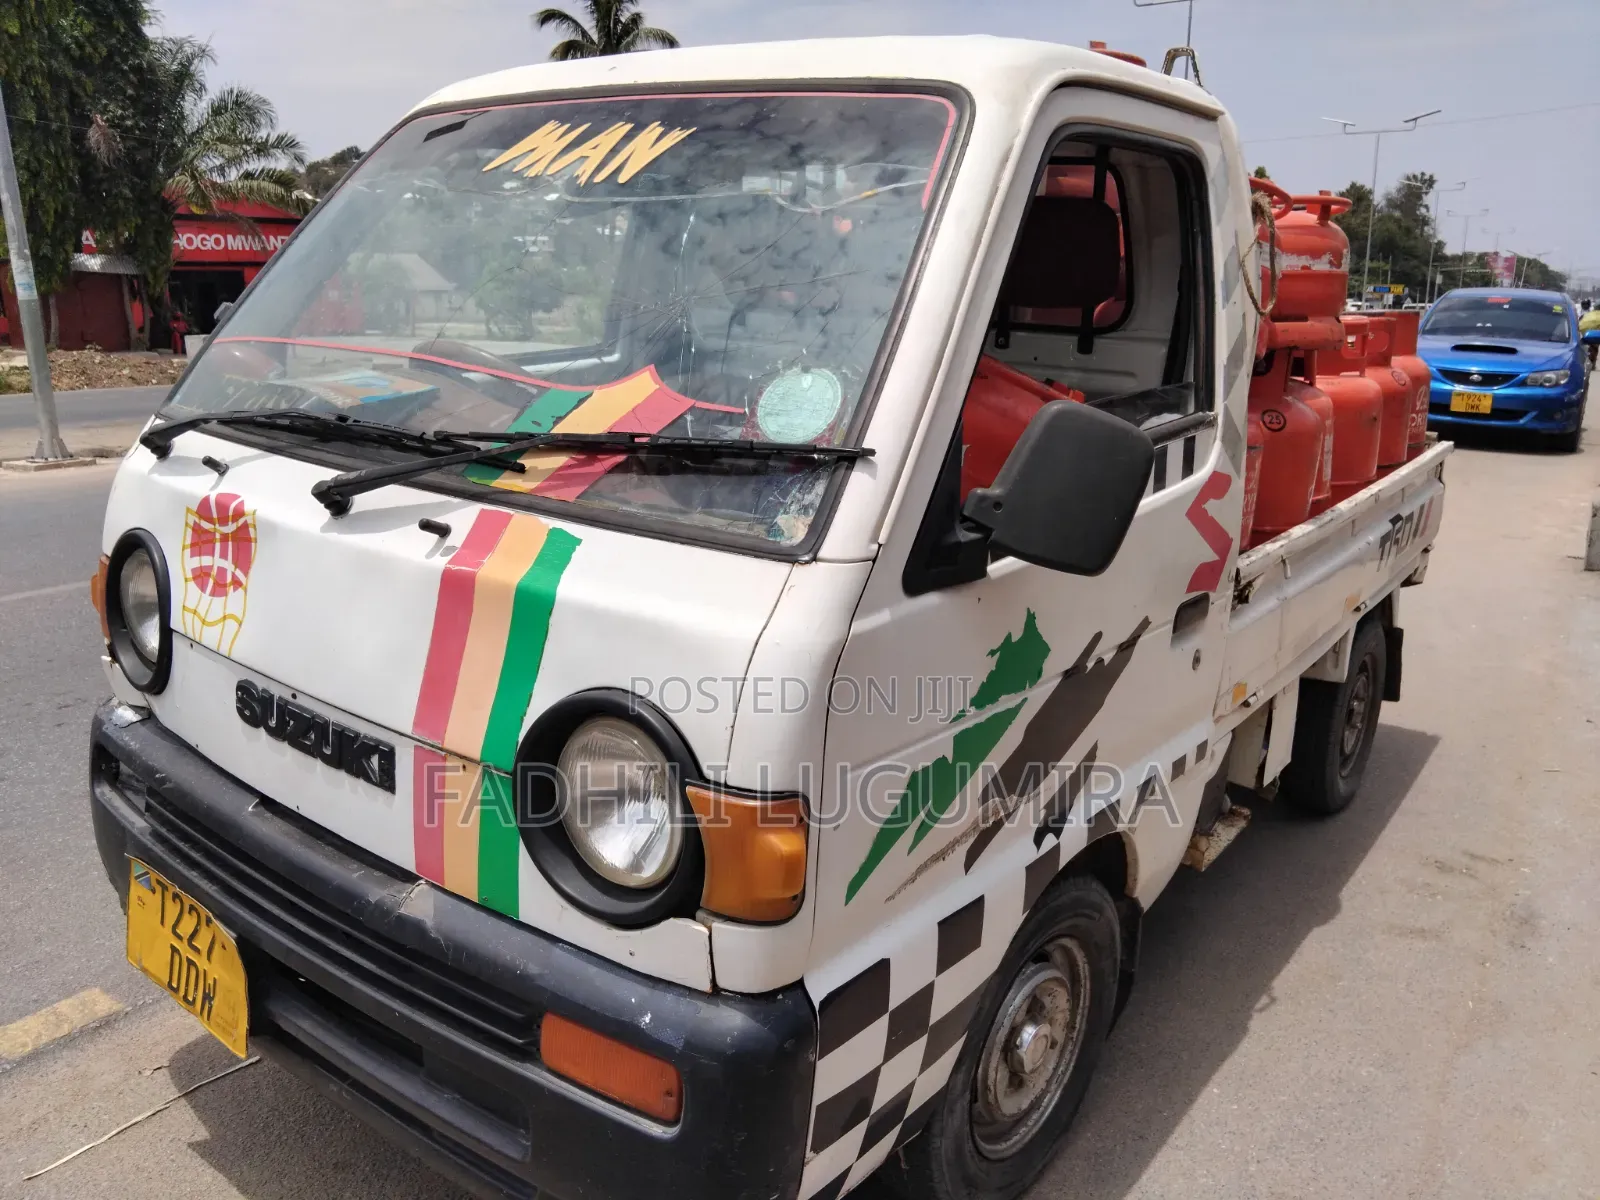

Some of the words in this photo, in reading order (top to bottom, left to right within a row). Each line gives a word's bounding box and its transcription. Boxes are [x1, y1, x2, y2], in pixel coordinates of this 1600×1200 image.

[483, 120, 697, 187] MAN
[1267, 414, 1283, 425] 25
[235, 678, 397, 795] SUZUKI
[155, 878, 218, 964] T227
[166, 942, 219, 1022] DDW
